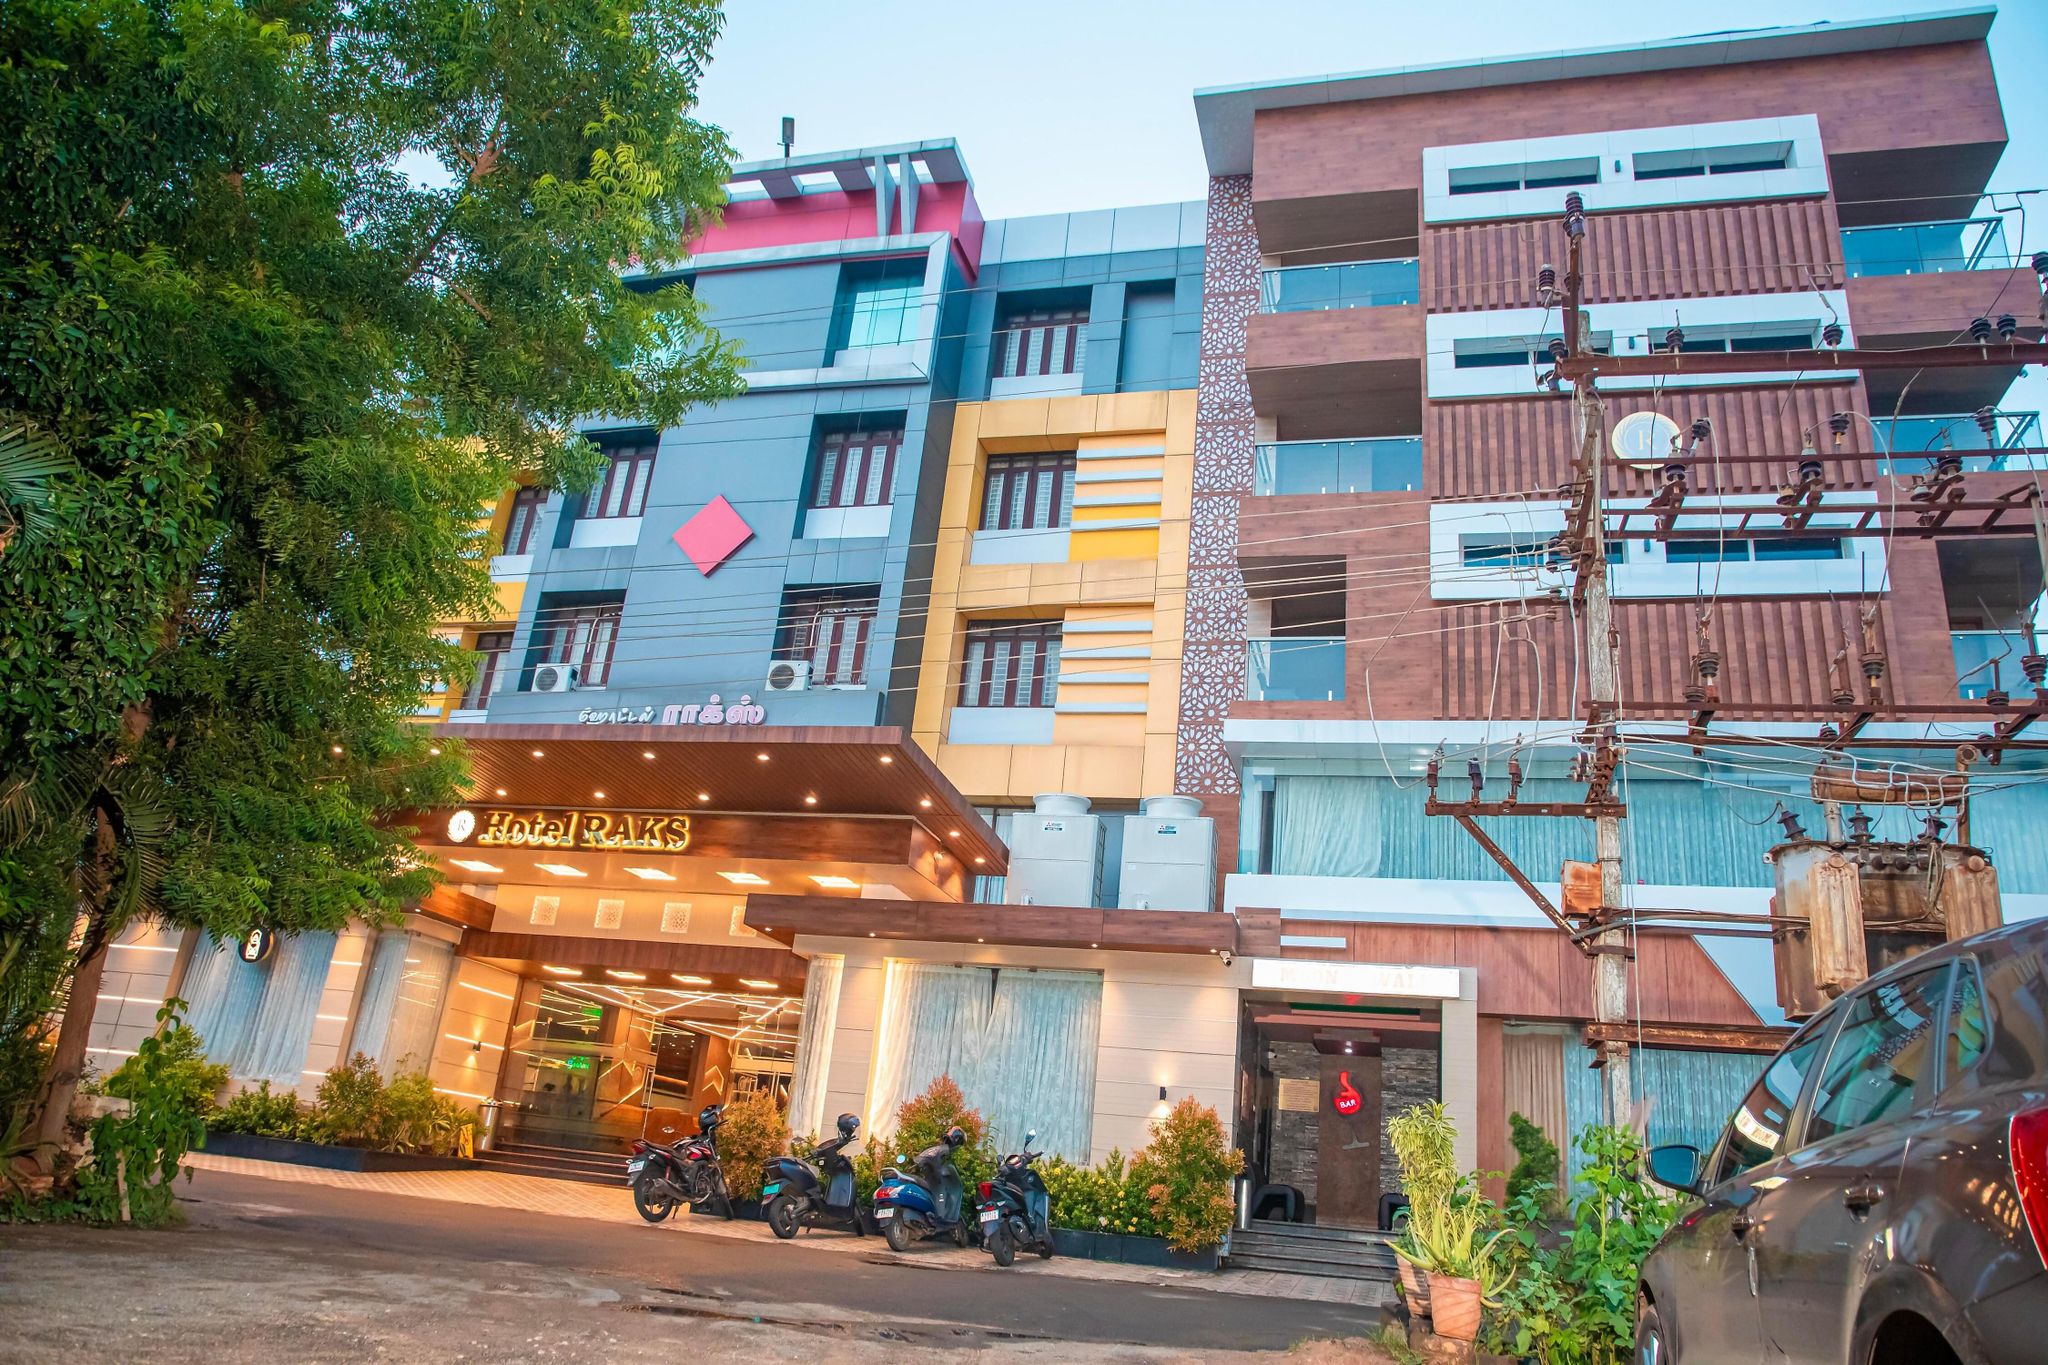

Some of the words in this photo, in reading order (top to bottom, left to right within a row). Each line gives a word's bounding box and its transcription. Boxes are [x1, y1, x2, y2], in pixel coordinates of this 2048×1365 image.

[1637, 429, 1658, 451] R
[578, 706, 655, 725] ஹோட்டல்
[661, 694, 766, 726] ராக்ஸ்
[479, 811, 578, 847] Hotel
[580, 813, 690, 850] RAKS
[1340, 1099, 1356, 1109] BAR
